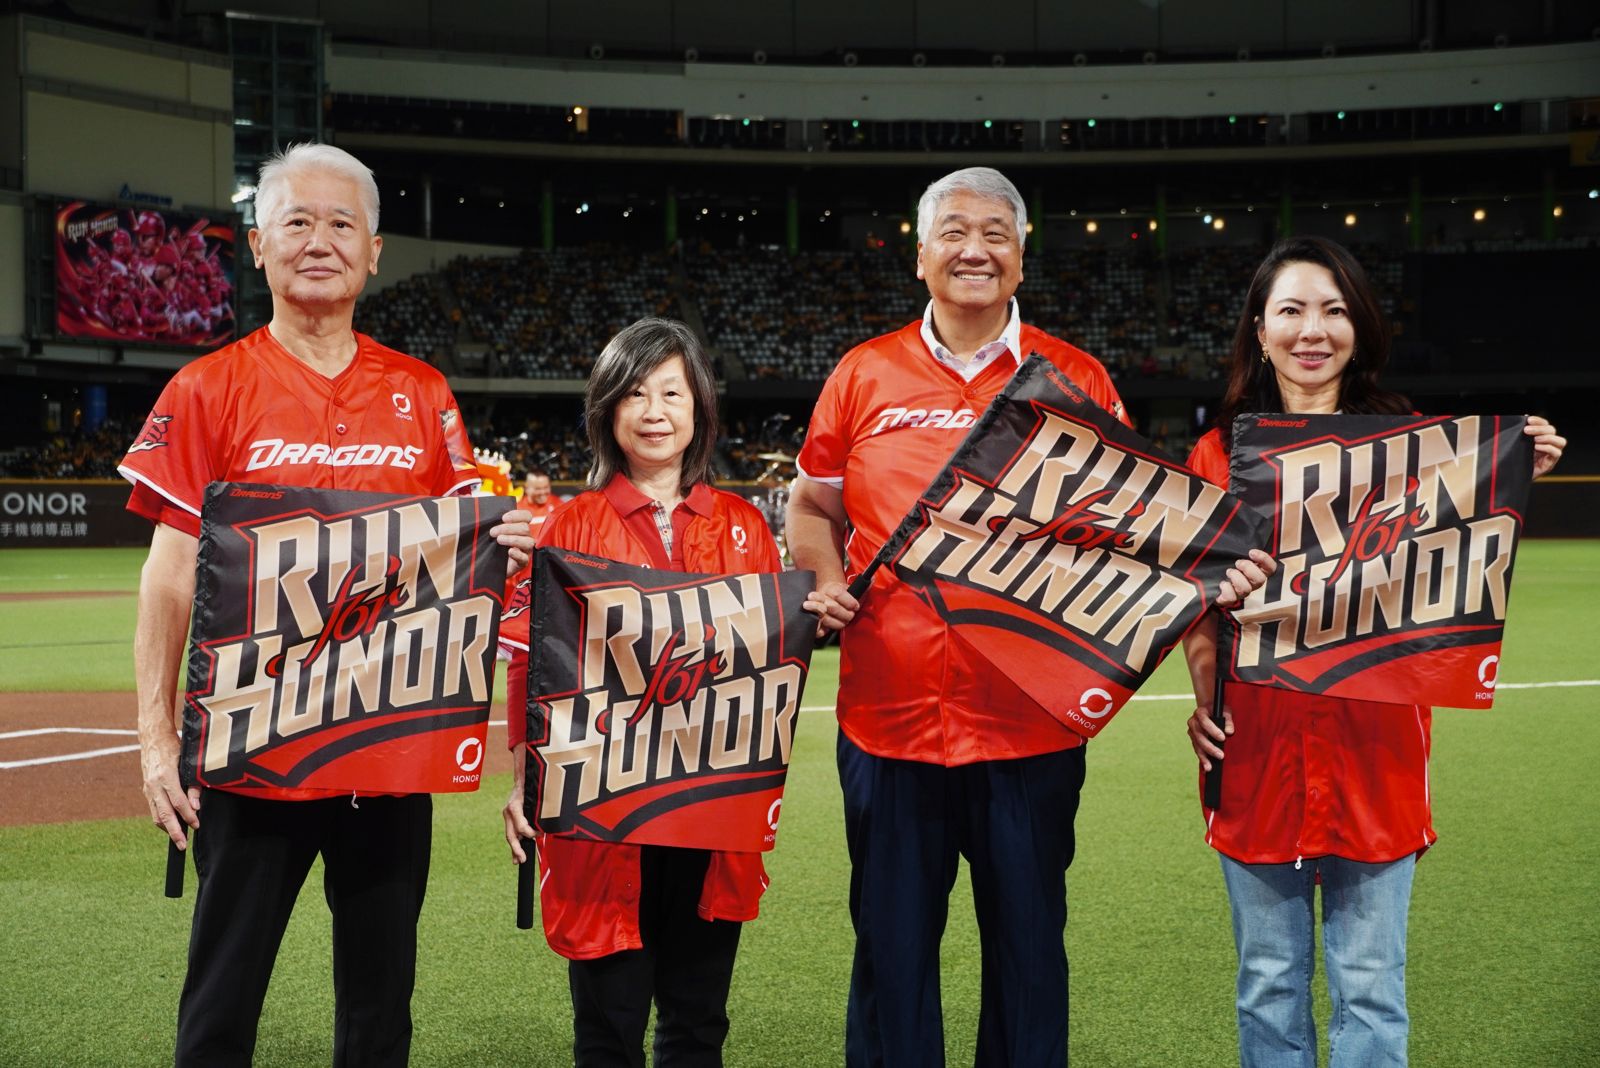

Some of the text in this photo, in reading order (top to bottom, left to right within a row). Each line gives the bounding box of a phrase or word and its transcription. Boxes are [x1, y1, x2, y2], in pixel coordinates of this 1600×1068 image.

[871, 407, 978, 435] DRAG
[3, 492, 88, 516] ONOR
[988, 490, 1144, 549] for
[997, 411, 1226, 569] RUN
[1276, 415, 1480, 558] RUN
[1291, 477, 1430, 594] for
[250, 497, 460, 638] RUN
[266, 554, 410, 676] for
[899, 477, 1198, 674] HONOR
[1230, 515, 1516, 668] HONOR
[198, 595, 494, 772] HONOR
[583, 573, 768, 696] RUN
[596, 624, 728, 734] for
[452, 774, 480, 783] HONOR
[536, 663, 801, 819] HONOR
[1066, 709, 1097, 731] HONOR
